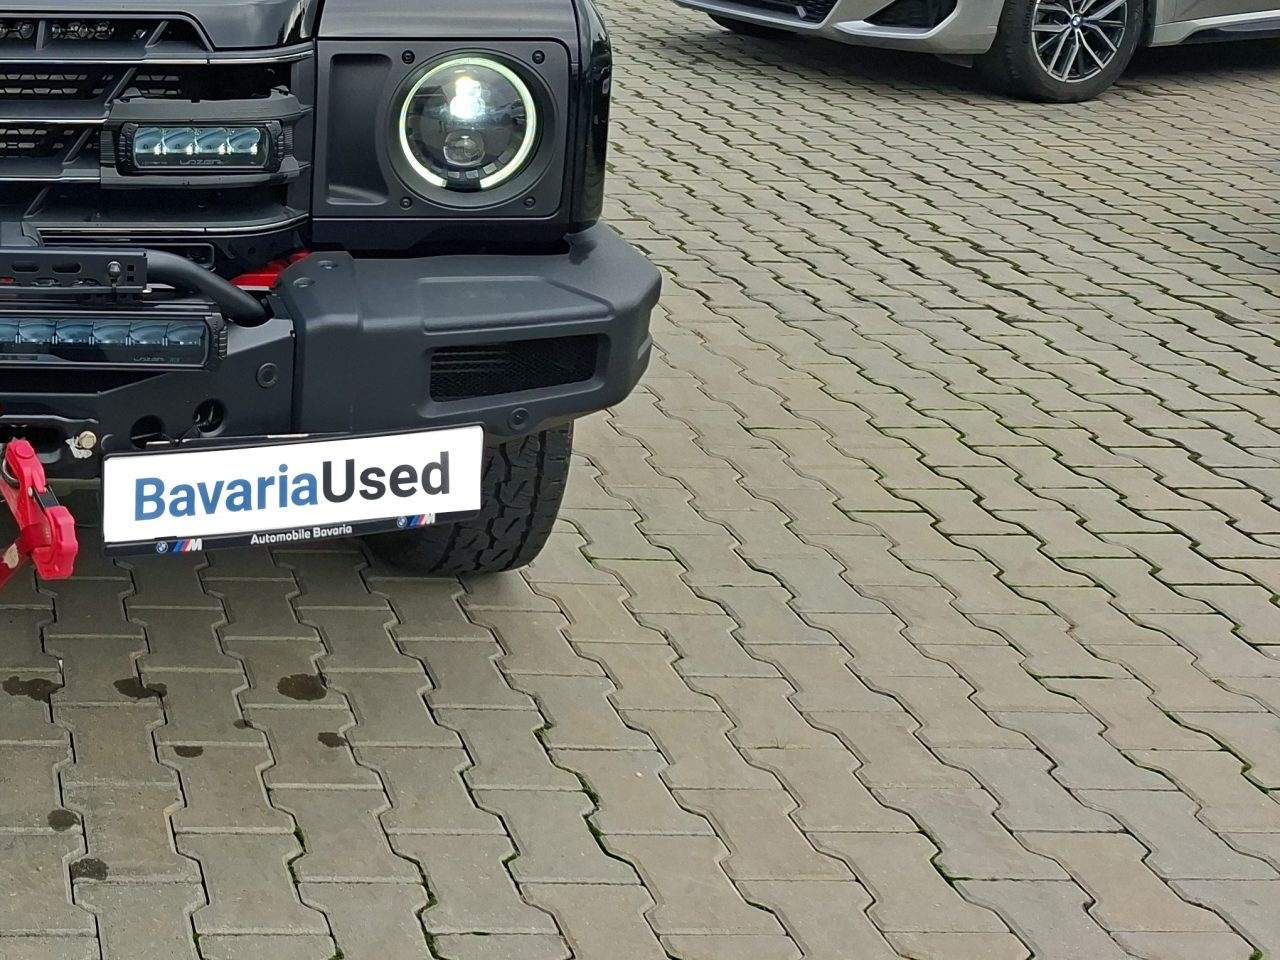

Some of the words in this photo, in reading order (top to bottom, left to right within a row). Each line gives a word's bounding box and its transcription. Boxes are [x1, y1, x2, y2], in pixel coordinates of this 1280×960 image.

[134, 451, 451, 521] BavariaUsed
[250, 528, 311, 544] Automobile
[312, 524, 352, 538] Bavaria
